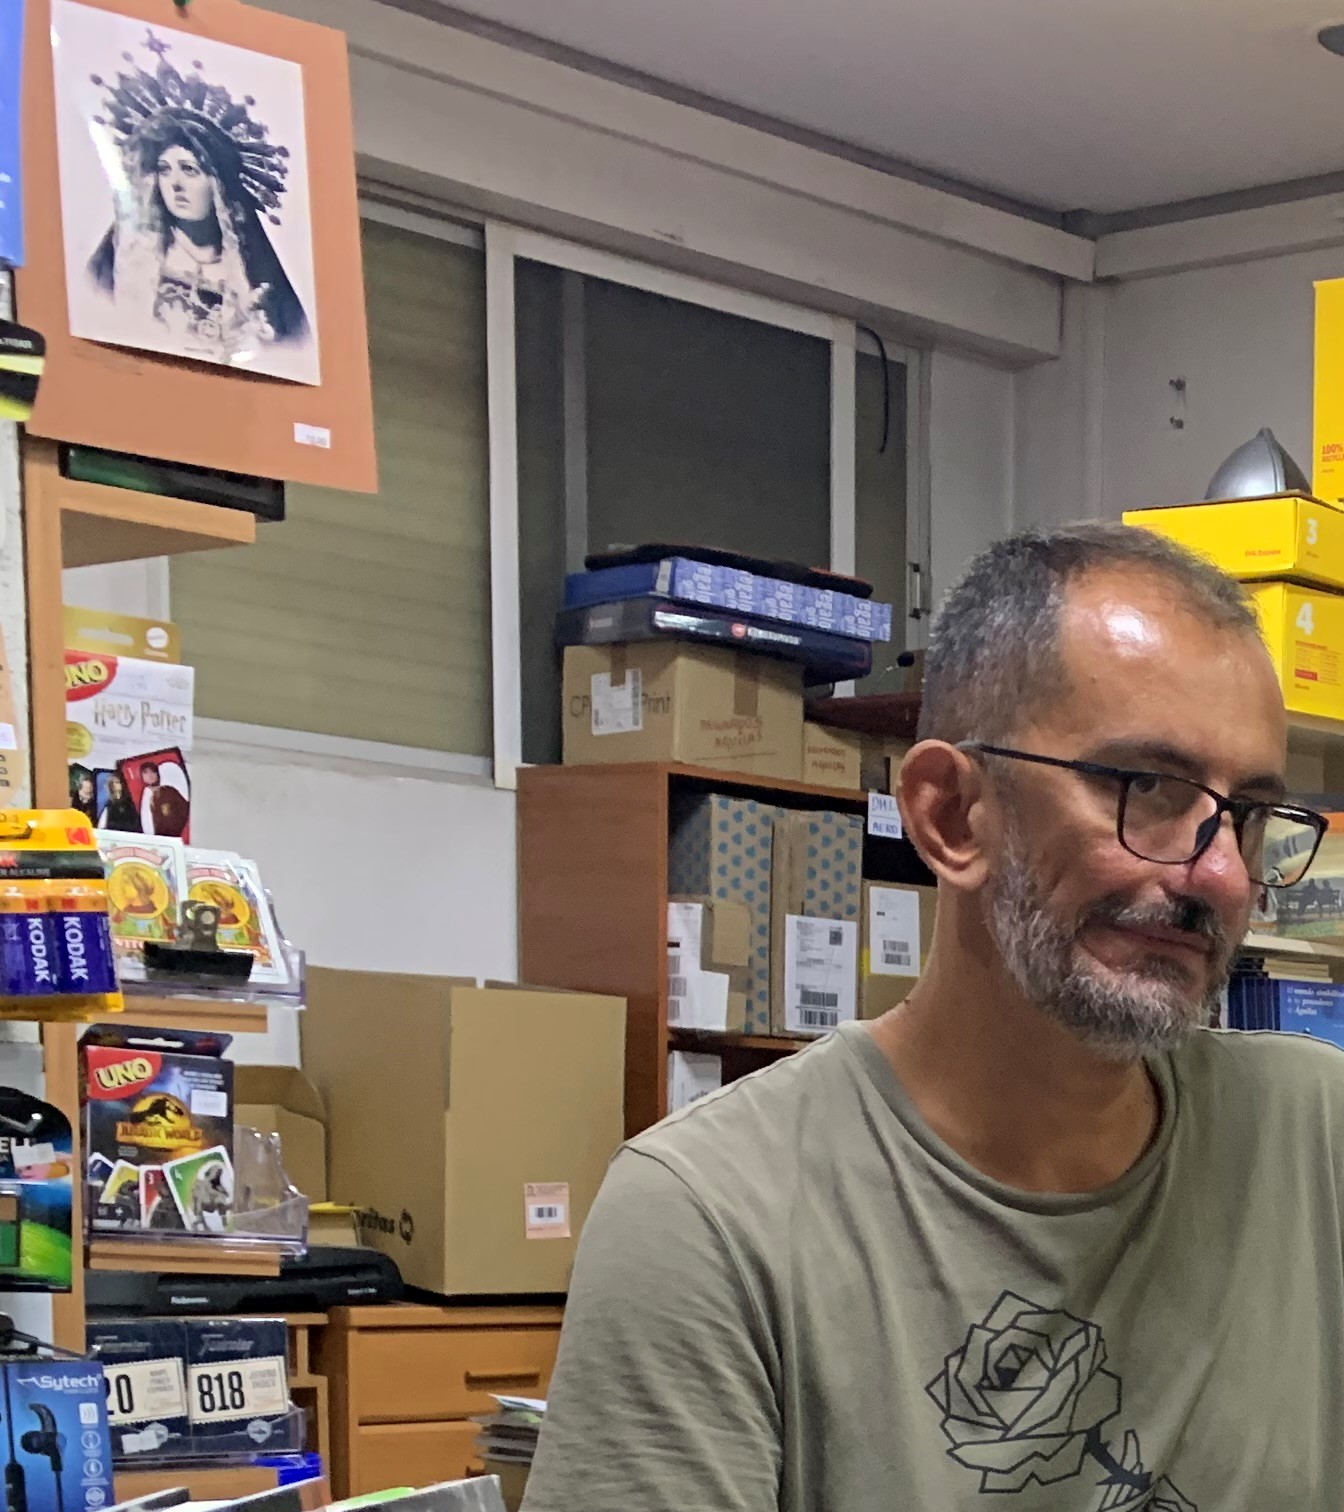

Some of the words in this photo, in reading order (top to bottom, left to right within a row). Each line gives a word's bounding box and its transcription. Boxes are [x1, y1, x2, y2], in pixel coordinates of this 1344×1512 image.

[1306, 519, 1318, 544] 3
[1296, 602, 1314, 635] 4
[94, 702, 135, 727] Harry
[141, 701, 187, 733] Potter
[27, 918, 50, 982] KODAK
[63, 917, 89, 981] KODAK
[95, 1057, 153, 1090] UNO
[40, 1374, 99, 1391] Sytech
[198, 1370, 245, 1413] 818
